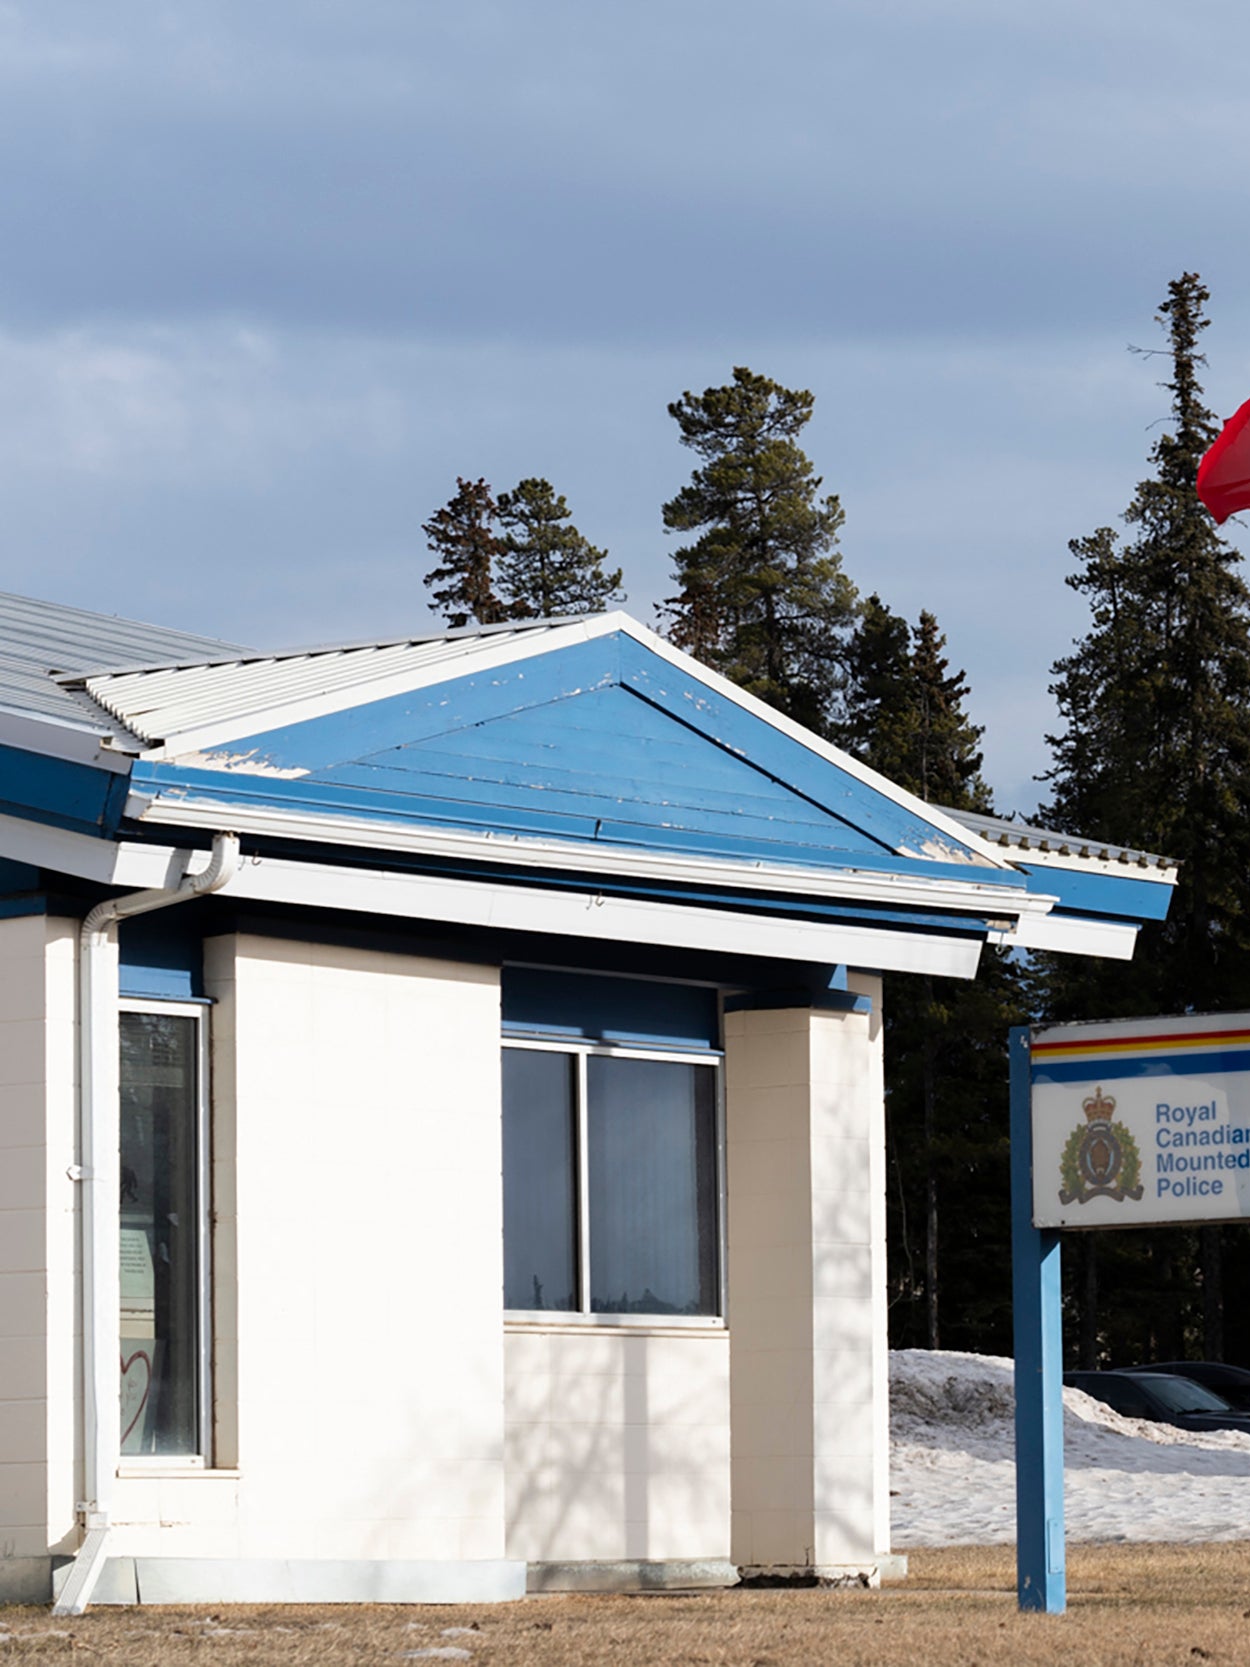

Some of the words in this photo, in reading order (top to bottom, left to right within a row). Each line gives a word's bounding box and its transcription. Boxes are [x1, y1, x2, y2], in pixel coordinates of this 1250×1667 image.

[1155, 1101, 1217, 1127] Royal
[1156, 1149, 1250, 1173] Mounted
[1157, 1176, 1223, 1198] Police
